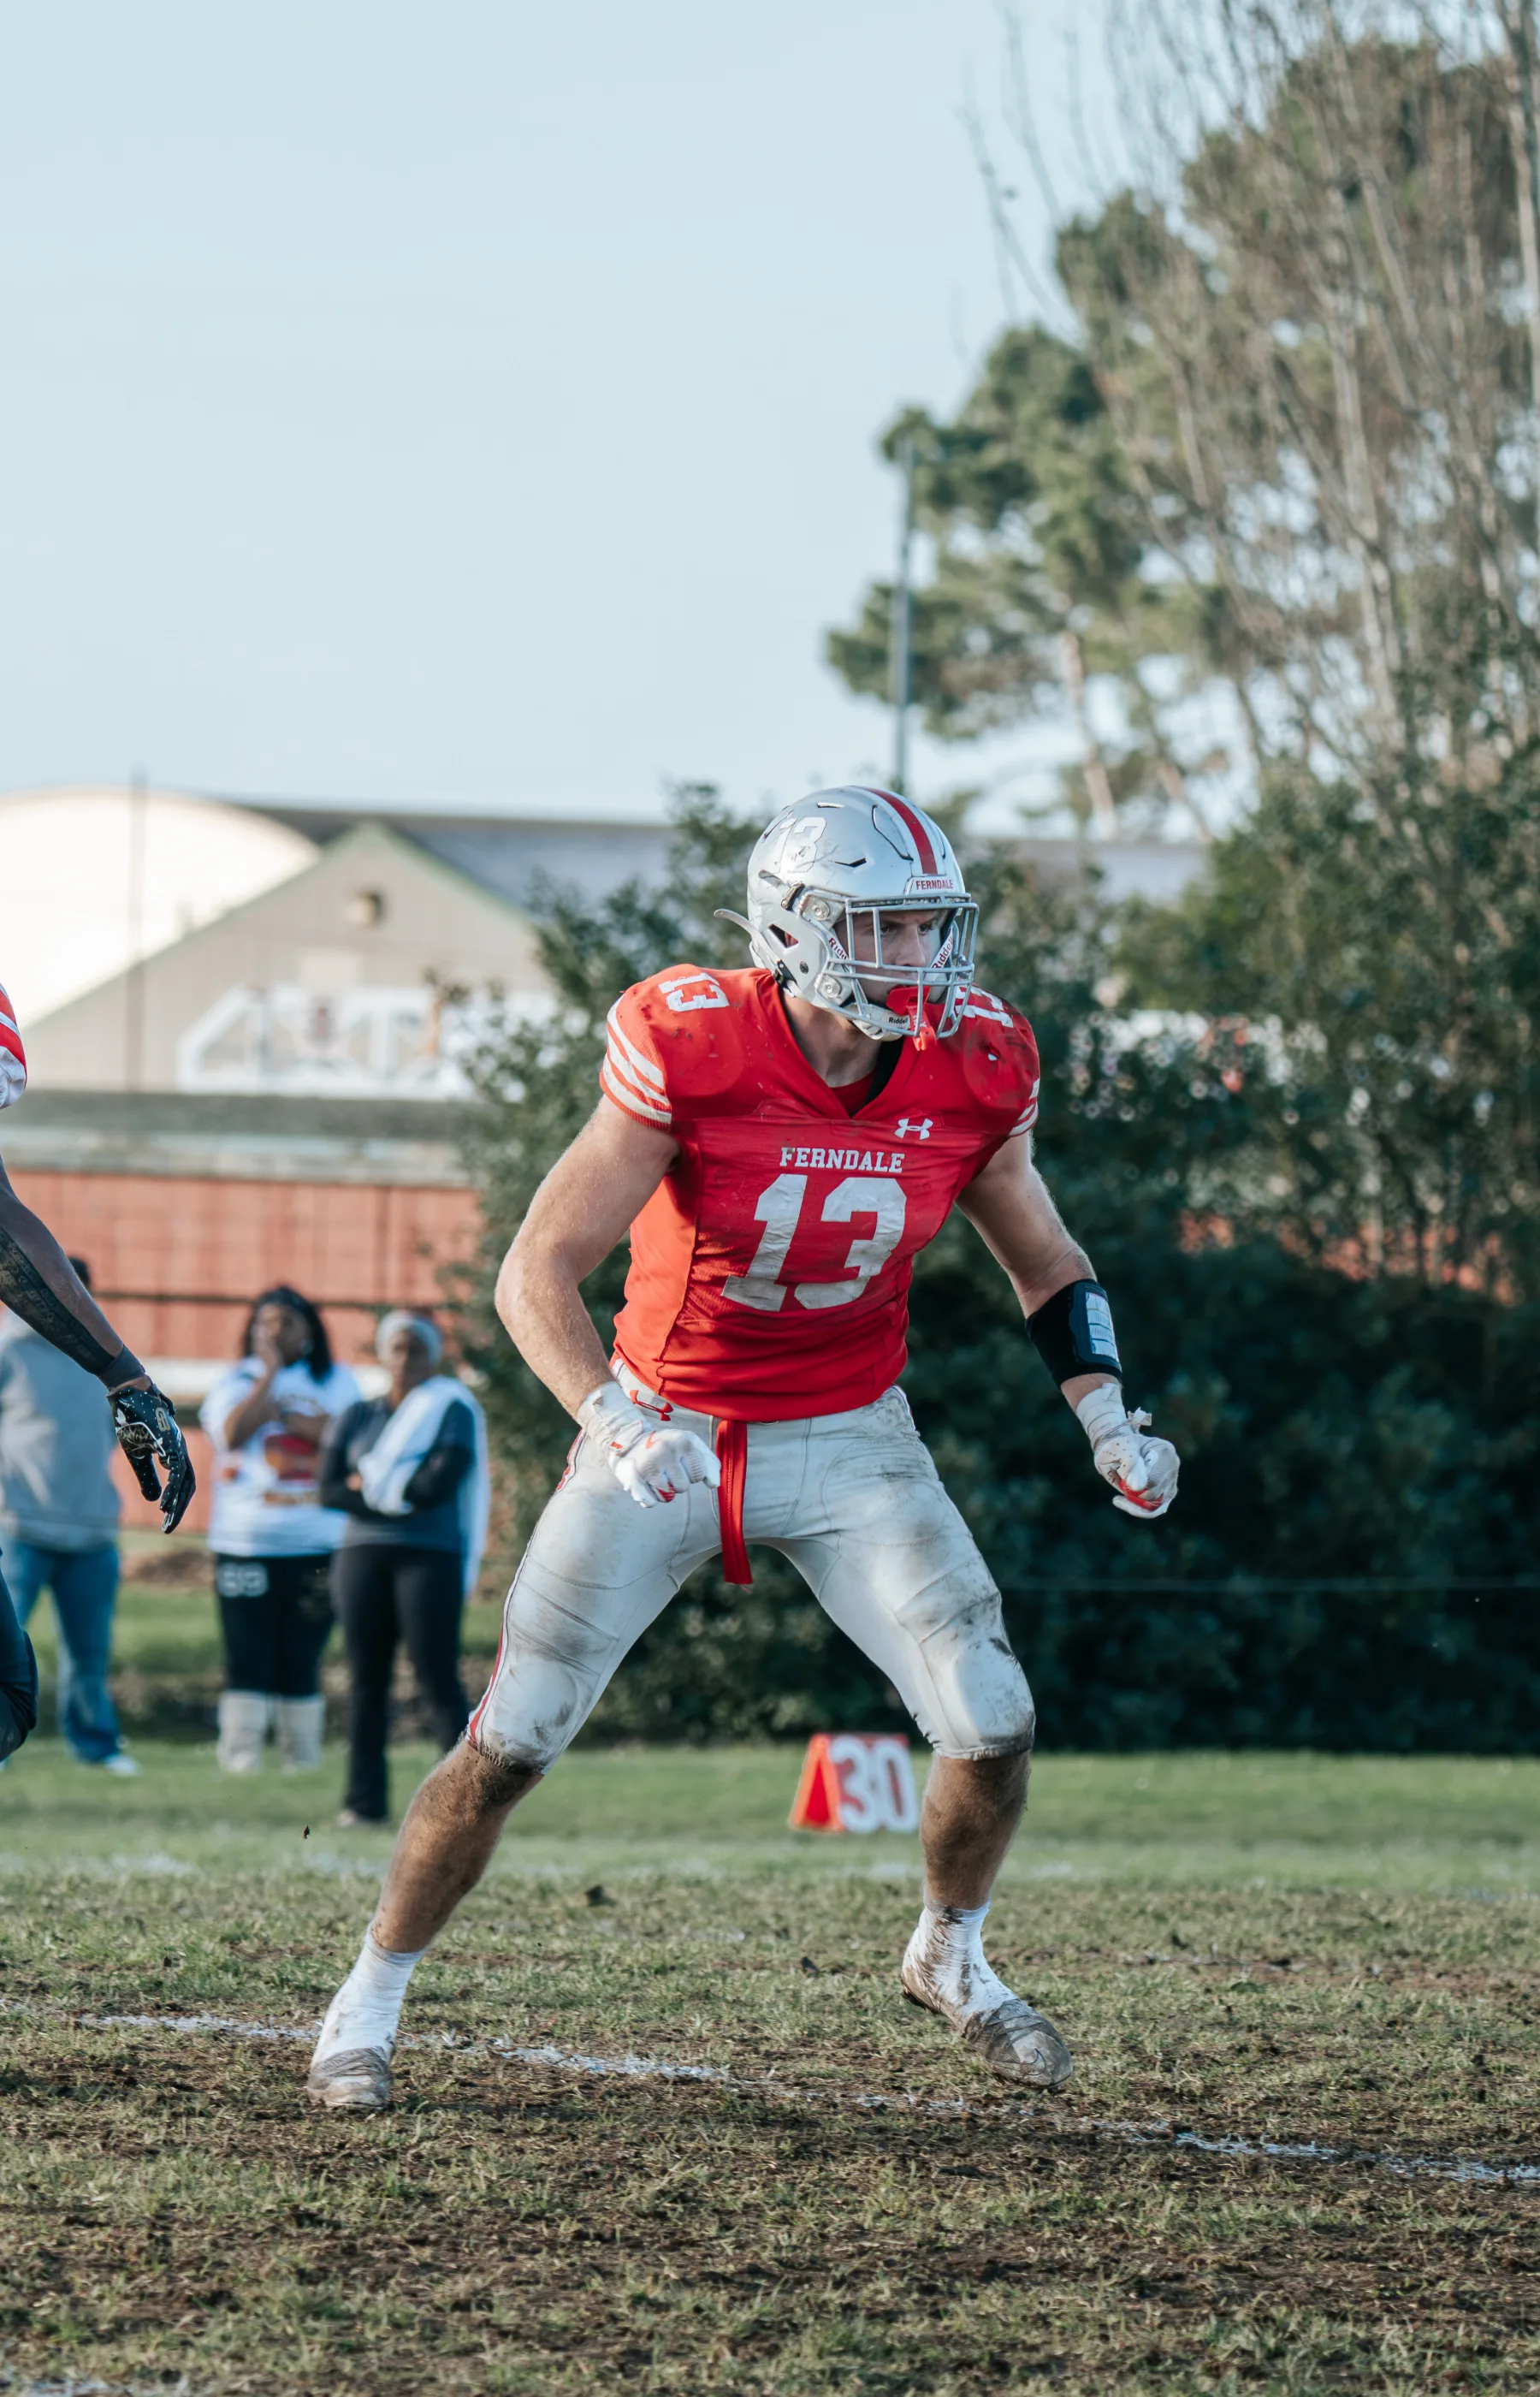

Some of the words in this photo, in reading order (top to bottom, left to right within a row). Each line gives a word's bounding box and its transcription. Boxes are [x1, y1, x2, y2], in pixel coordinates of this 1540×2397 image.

[773, 816, 826, 873] 13
[915, 879, 954, 891] FERNDALE
[828, 937, 847, 960] Ridd
[658, 972, 730, 1012] 13
[779, 1147, 905, 1173] FERNDALE
[721, 1173, 907, 1312] 13
[828, 1735, 919, 1834] 30
